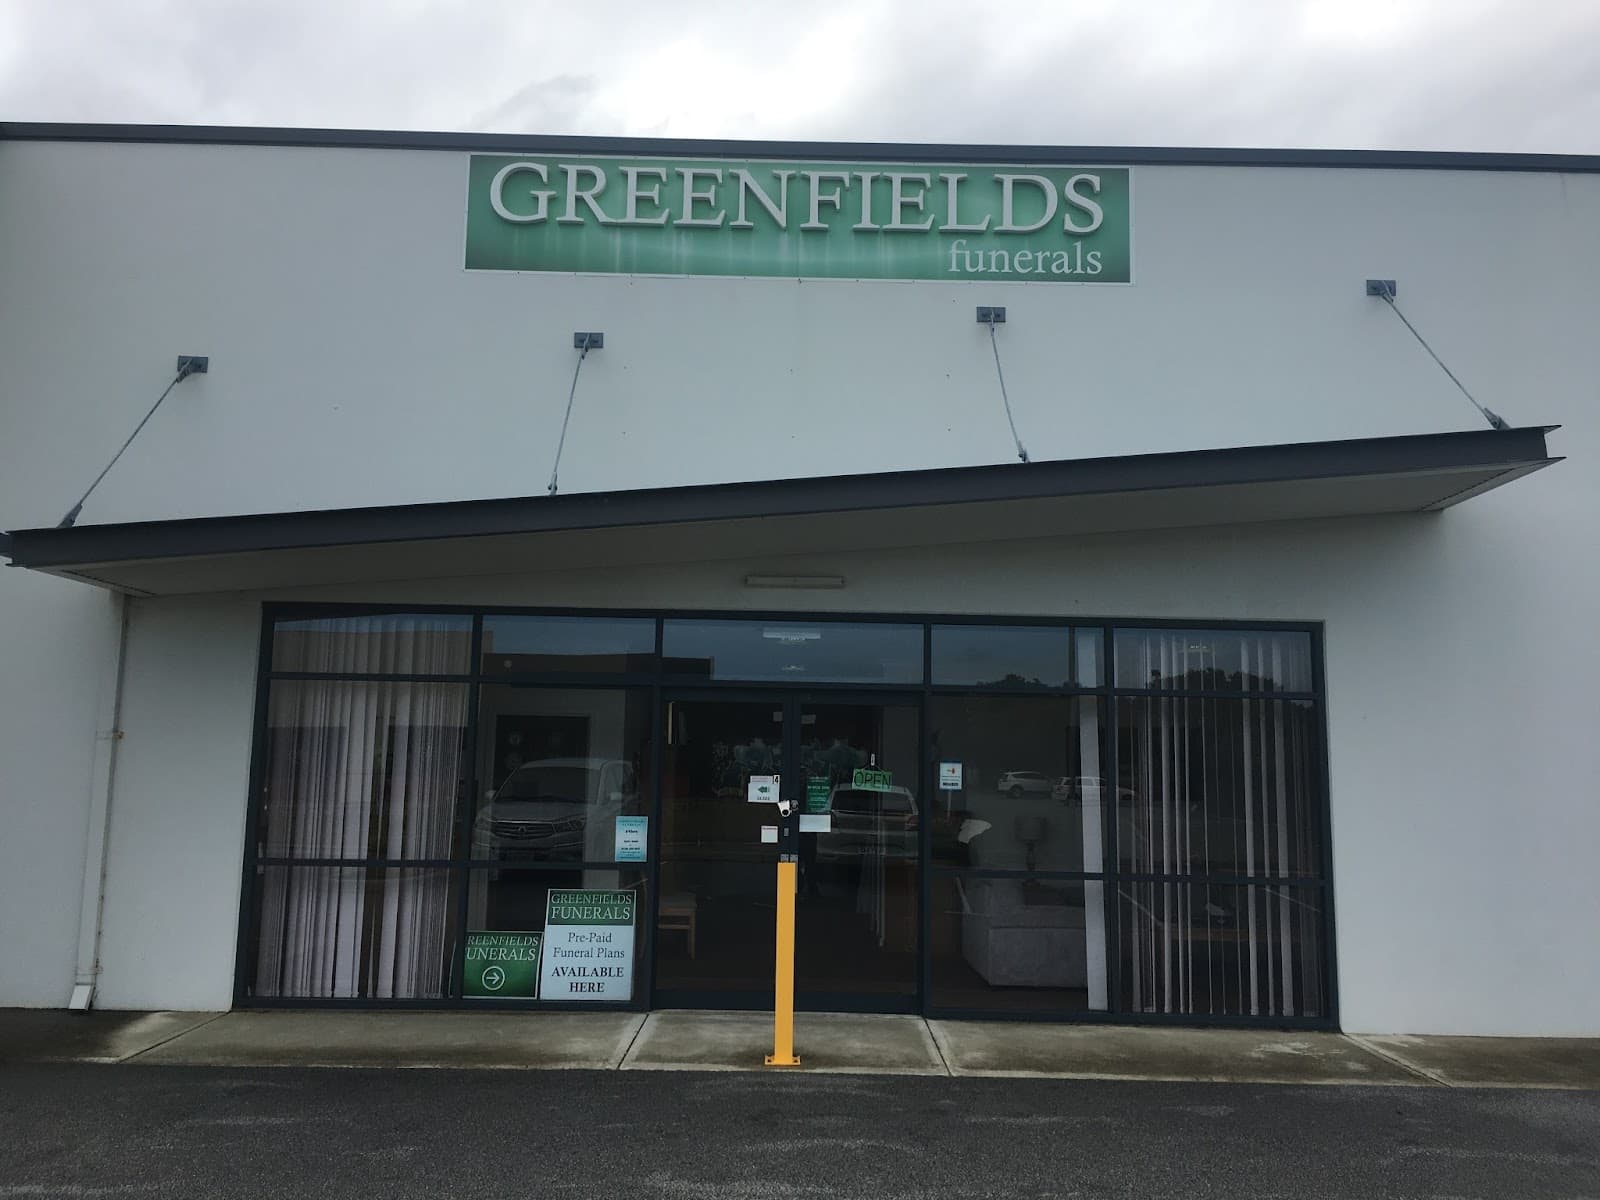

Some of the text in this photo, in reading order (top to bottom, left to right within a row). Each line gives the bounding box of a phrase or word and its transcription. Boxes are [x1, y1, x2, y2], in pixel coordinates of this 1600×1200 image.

[489, 161, 1105, 235] GREENFIELDS
[947, 239, 1103, 276] funerals
[854, 771, 892, 789] OPEN
[551, 893, 632, 905] GREENFIELDS
[551, 906, 631, 920] FUNERALS
[467, 935, 539, 947] REENFIELDS
[568, 932, 612, 943] Pre-Paid
[465, 947, 536, 960] UNERALS
[552, 947, 625, 958] Funeral Plans
[551, 966, 625, 978] AVAILABLE
[569, 982, 605, 993] HERE
